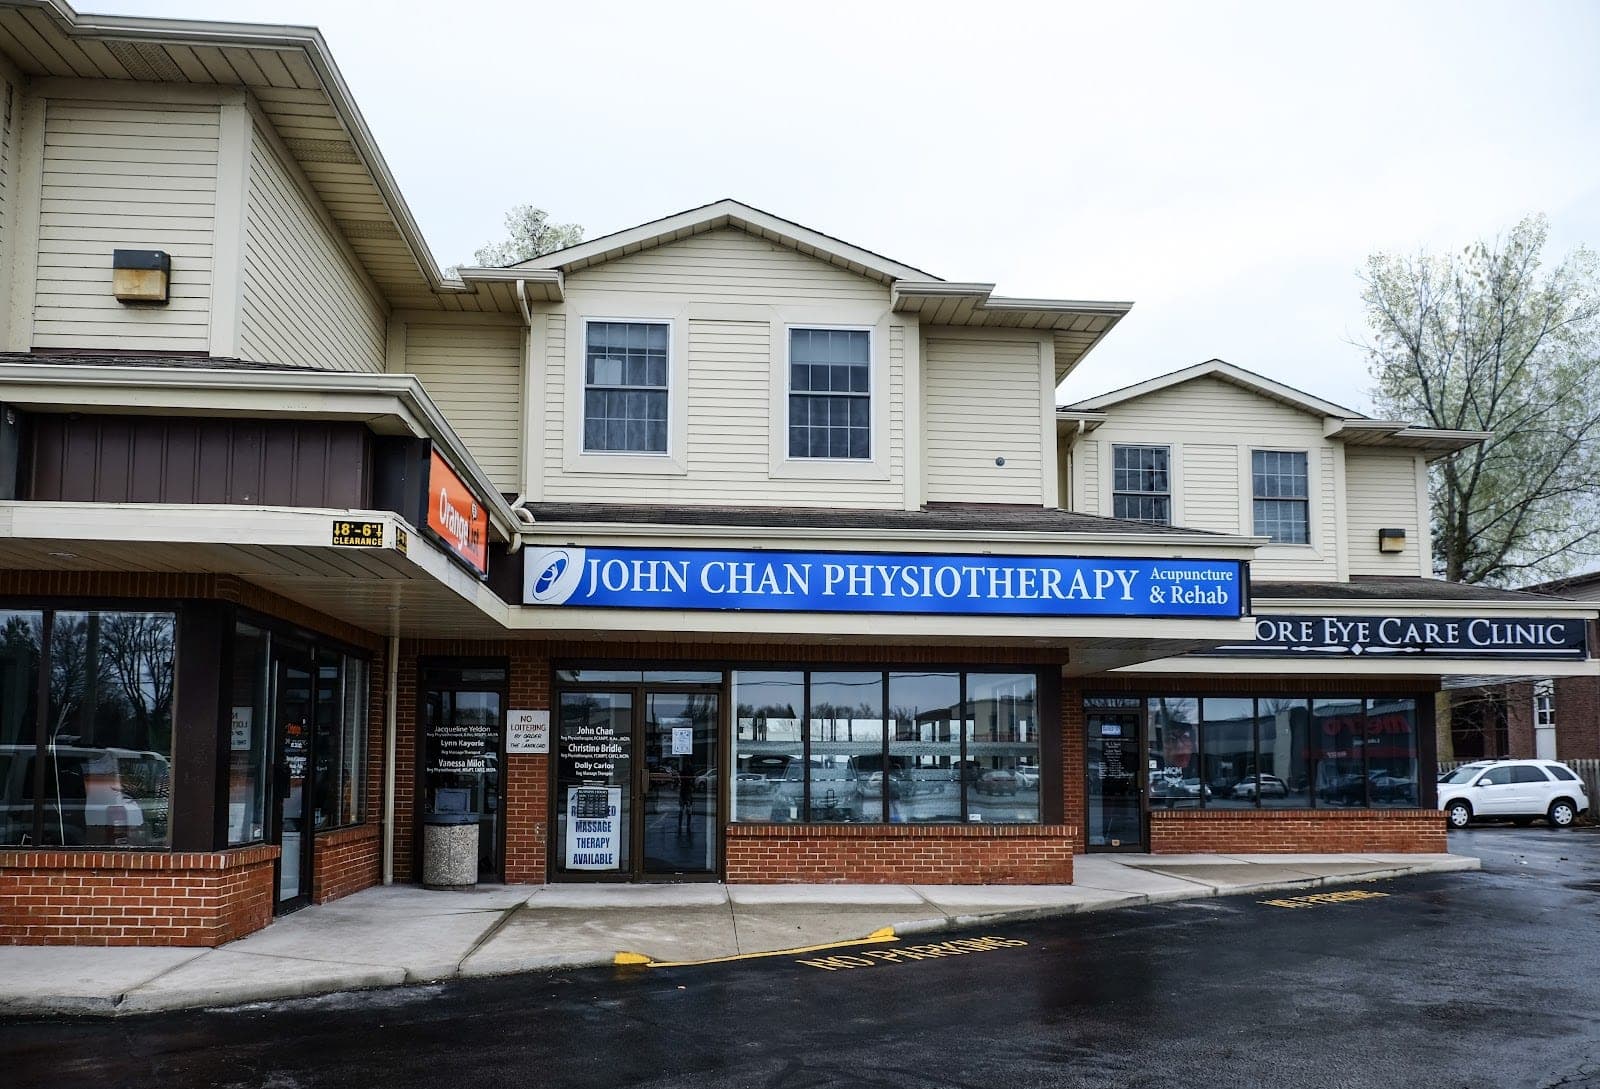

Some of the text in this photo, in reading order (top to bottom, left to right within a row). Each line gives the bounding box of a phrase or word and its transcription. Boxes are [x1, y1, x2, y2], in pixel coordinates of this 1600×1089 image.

[438, 487, 470, 550] Orange
[333, 536, 383, 546] CLEARANCE
[586, 558, 1139, 601] JOHN CHAN PHYSIOTHERAPY
[1149, 567, 1234, 583] Acupuncture
[1149, 585, 1229, 605] & Rehab
[520, 715, 533, 723] NO
[510, 724, 547, 732] LOITERING
[576, 726, 614, 736] John Chan
[440, 739, 458, 748] Lynn
[567, 743, 623, 753] Christine Bridle
[438, 758, 466, 768] Vanessa
[574, 762, 593, 770] Dolly
[575, 821, 612, 833] MASSAGE
[576, 837, 610, 849] THERAPY
[573, 853, 613, 865] AVAILABLE
[794, 936, 1030, 971] NO PARKING
